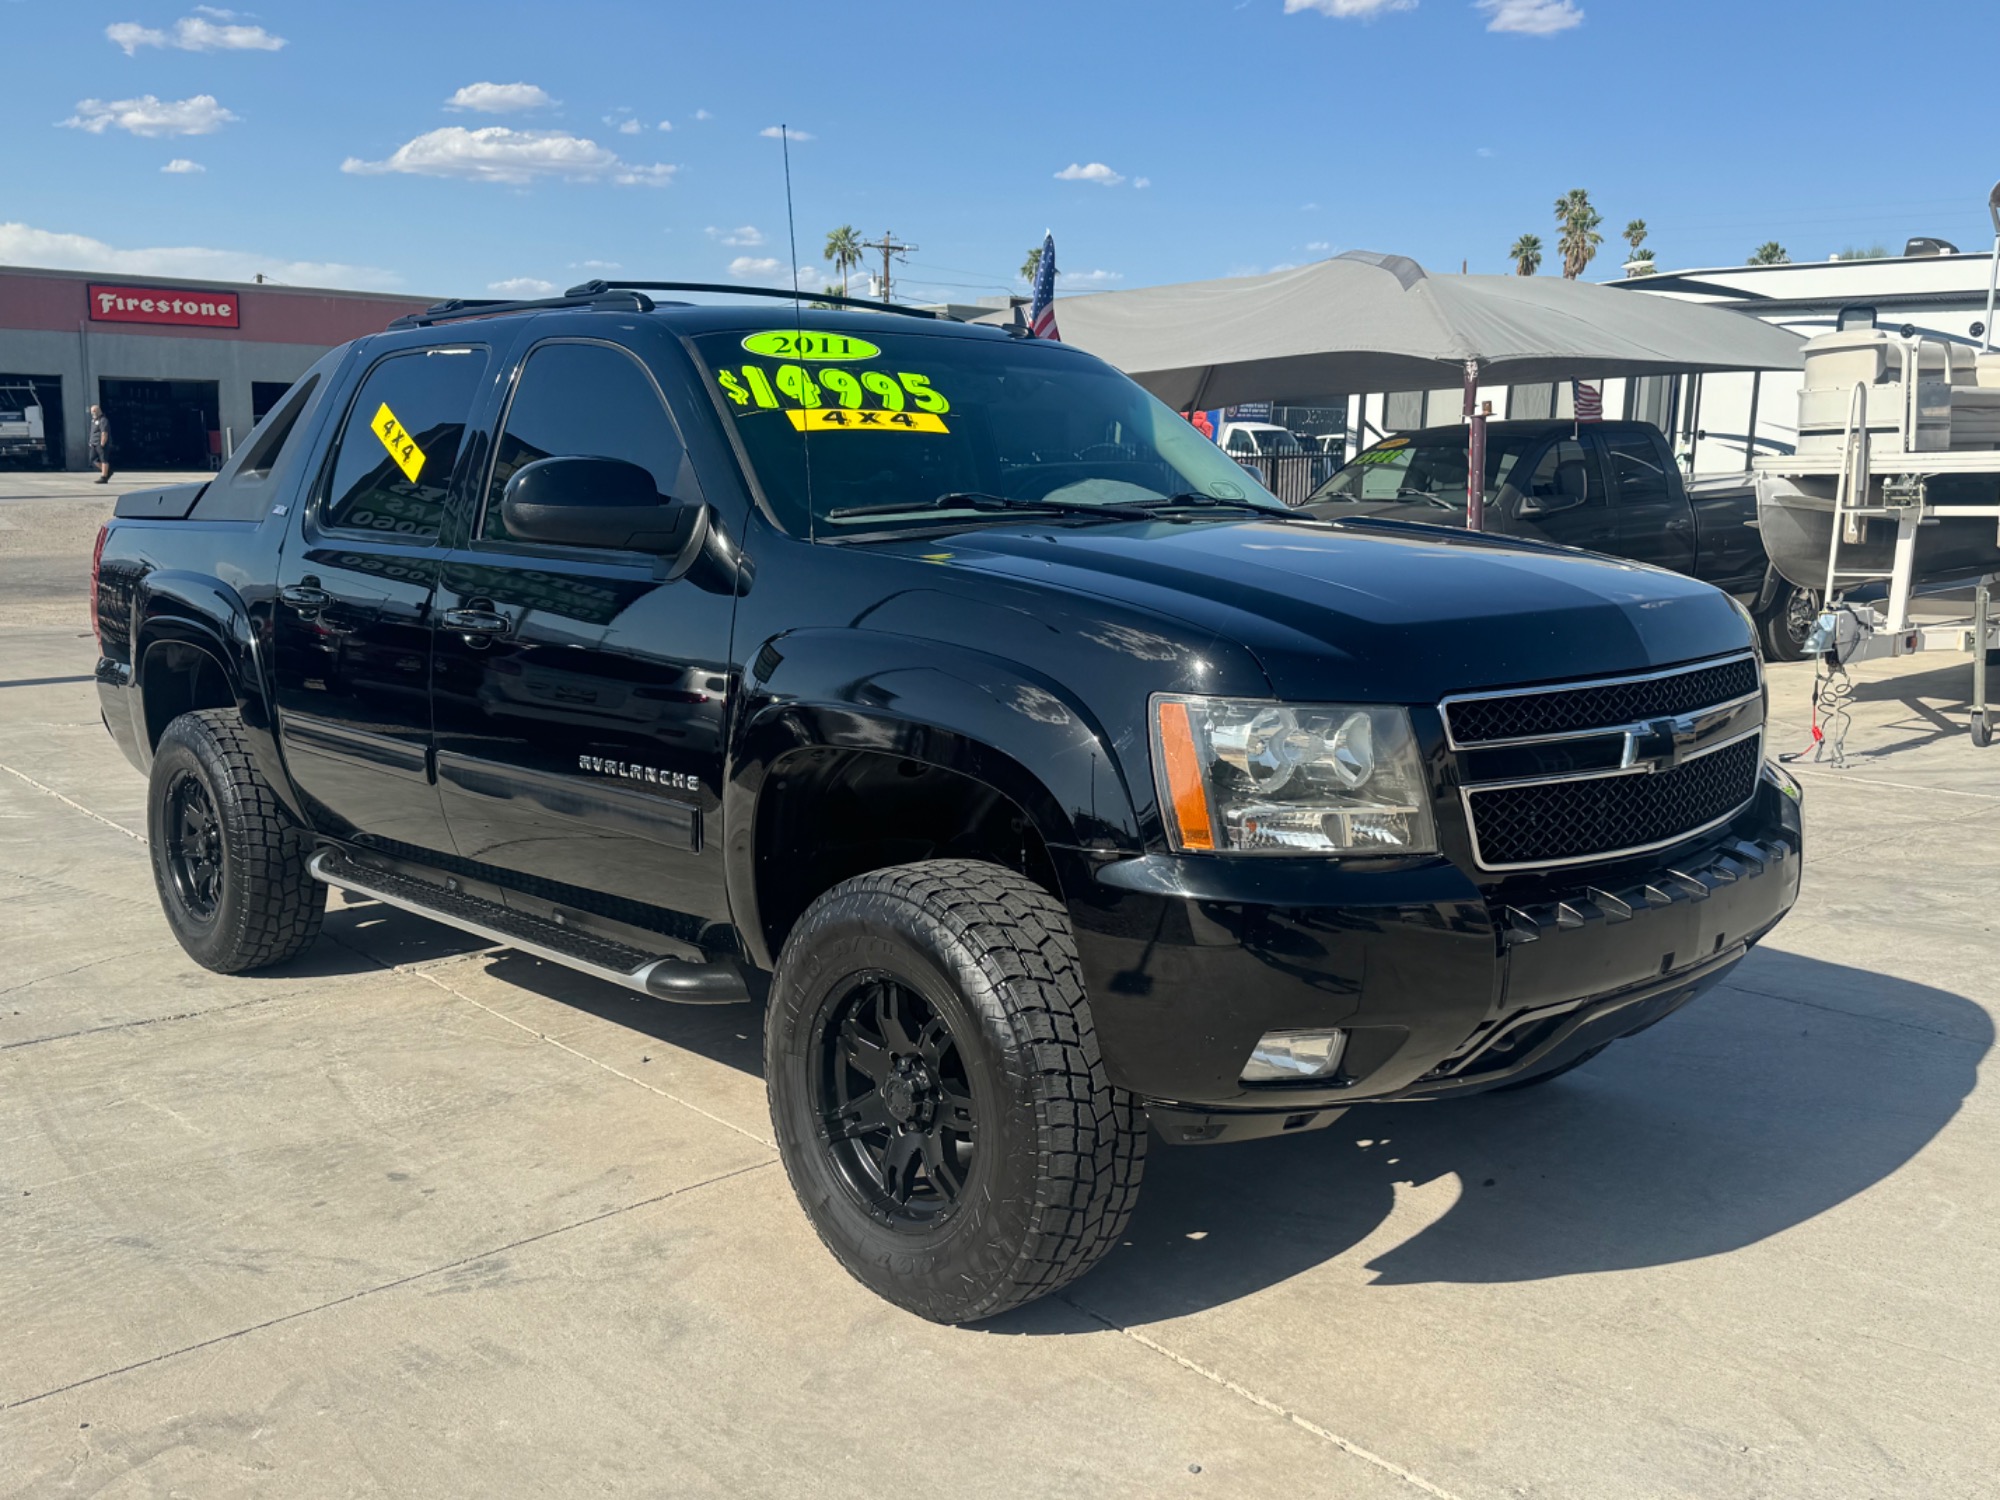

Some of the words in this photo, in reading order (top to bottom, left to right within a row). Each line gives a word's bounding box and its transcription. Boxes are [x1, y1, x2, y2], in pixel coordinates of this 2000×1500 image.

[97, 292, 232, 317] Firestone
[772, 336, 853, 354] 2011
[718, 364, 950, 414] $14995
[579, 755, 700, 791] AVALANCHE
